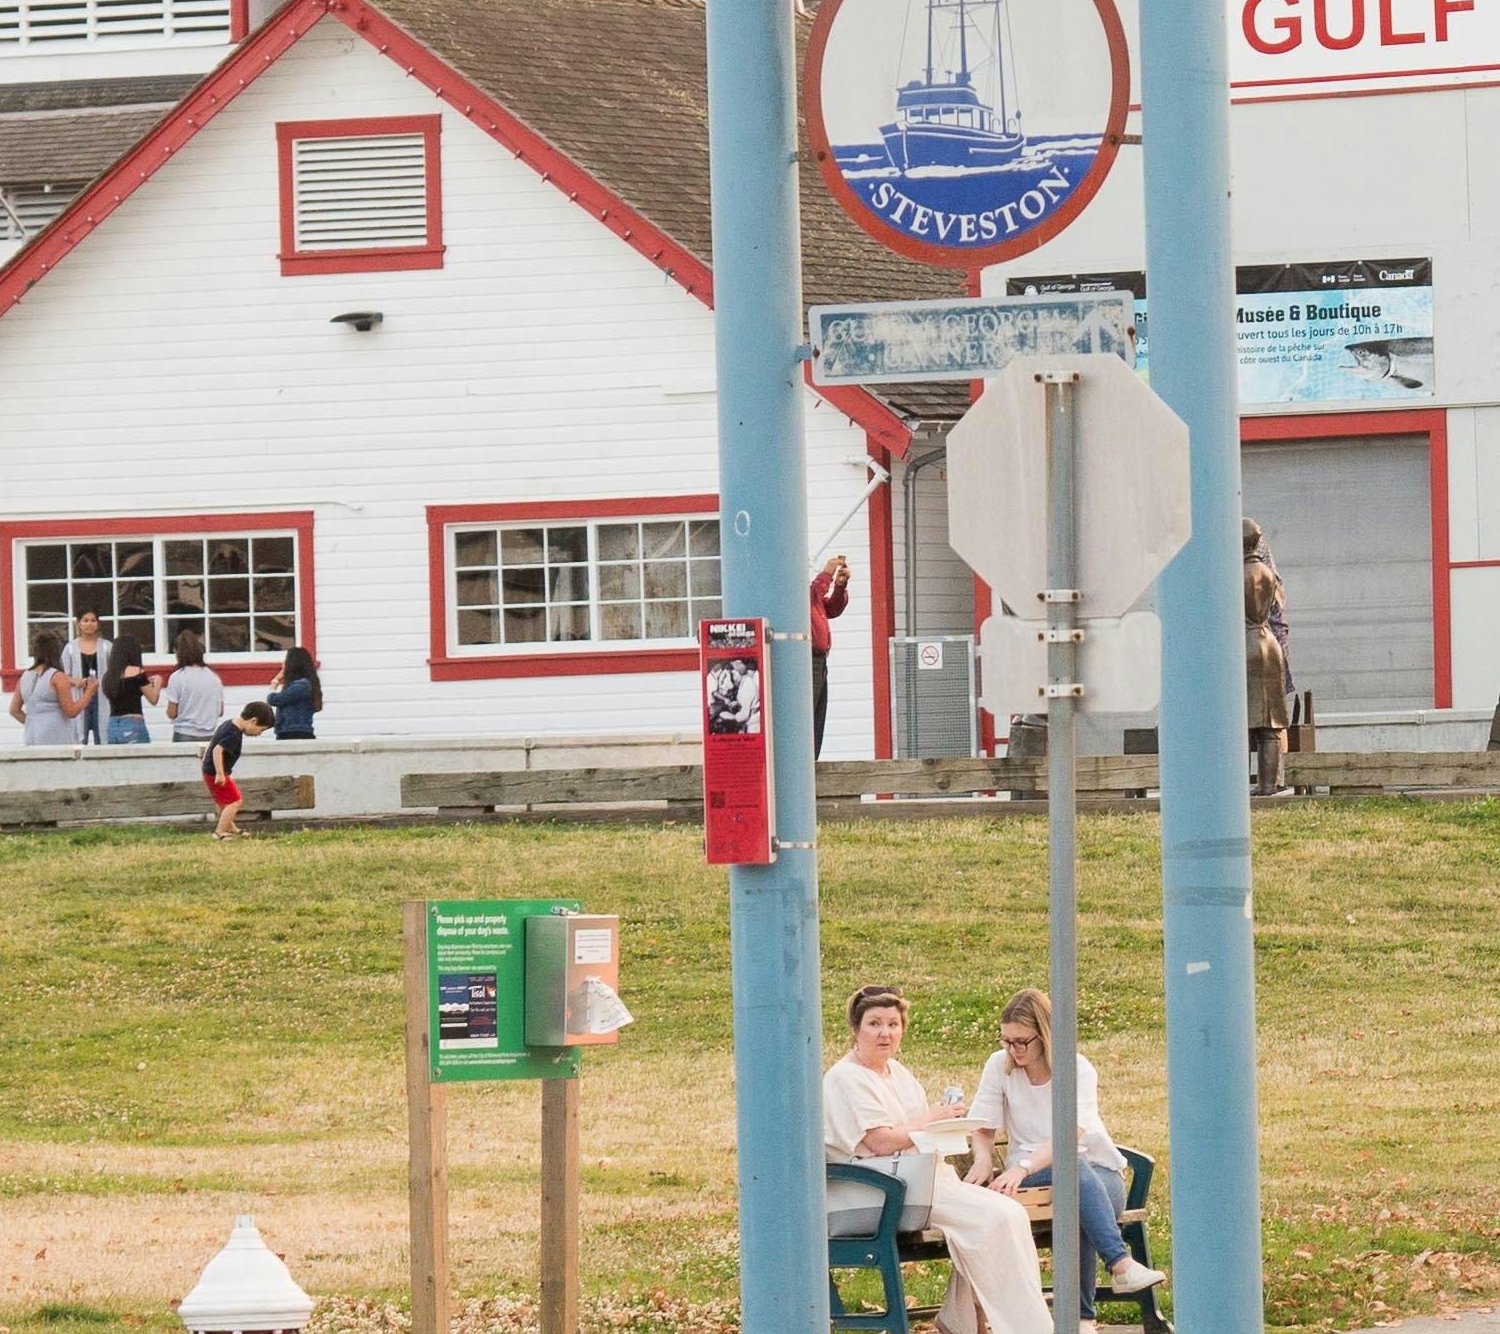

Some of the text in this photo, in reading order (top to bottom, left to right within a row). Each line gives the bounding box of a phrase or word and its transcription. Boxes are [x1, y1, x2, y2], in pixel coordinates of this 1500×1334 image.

[871, 165, 1070, 243] STEVESTON
[1379, 269, 1415, 281] Canada
[1289, 305, 1301, 321] &
[1306, 303, 1381, 322] Boutique
[1238, 331, 1264, 340] uvert
[1268, 329, 1289, 338] tous
[1291, 327, 1307, 338] les
[1309, 326, 1335, 339] jours
[1337, 327, 1350, 336] de
[1383, 323, 1403, 334] 17h
[709, 623, 746, 633] NIKKEI
